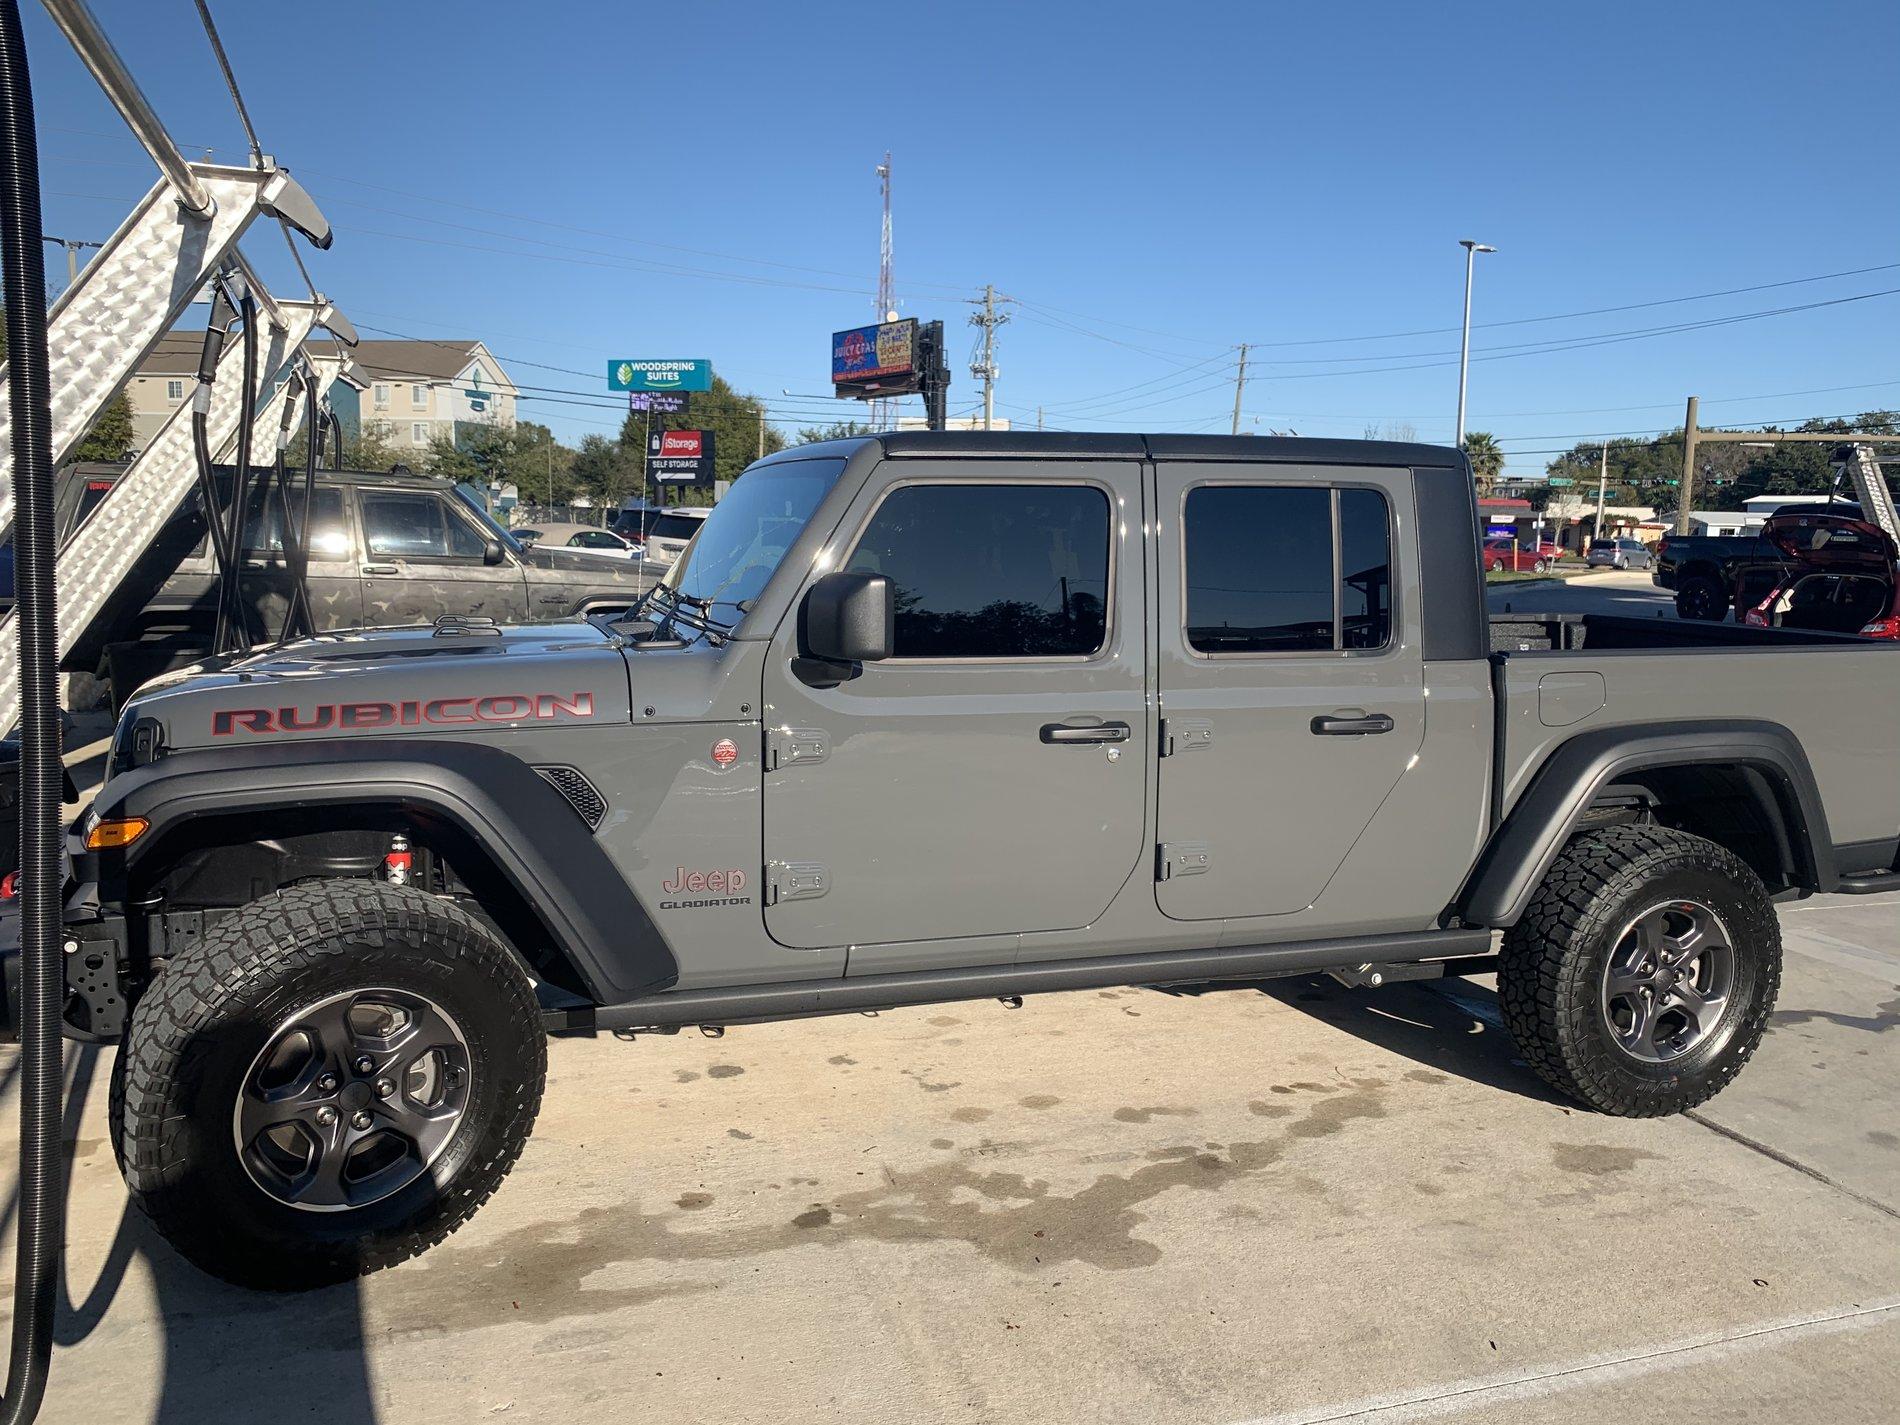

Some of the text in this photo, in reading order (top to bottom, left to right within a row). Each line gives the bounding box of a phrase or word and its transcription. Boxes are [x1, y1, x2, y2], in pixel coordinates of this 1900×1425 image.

[631, 362, 695, 371] WOODSPRING
[646, 372, 680, 381] SUITES
[664, 438, 698, 450] iStorage
[669, 460, 698, 468] STORAGE
[212, 691, 594, 736] RUBICON
[662, 866, 747, 896] Jeep
[659, 896, 751, 910] GLADIATOR
